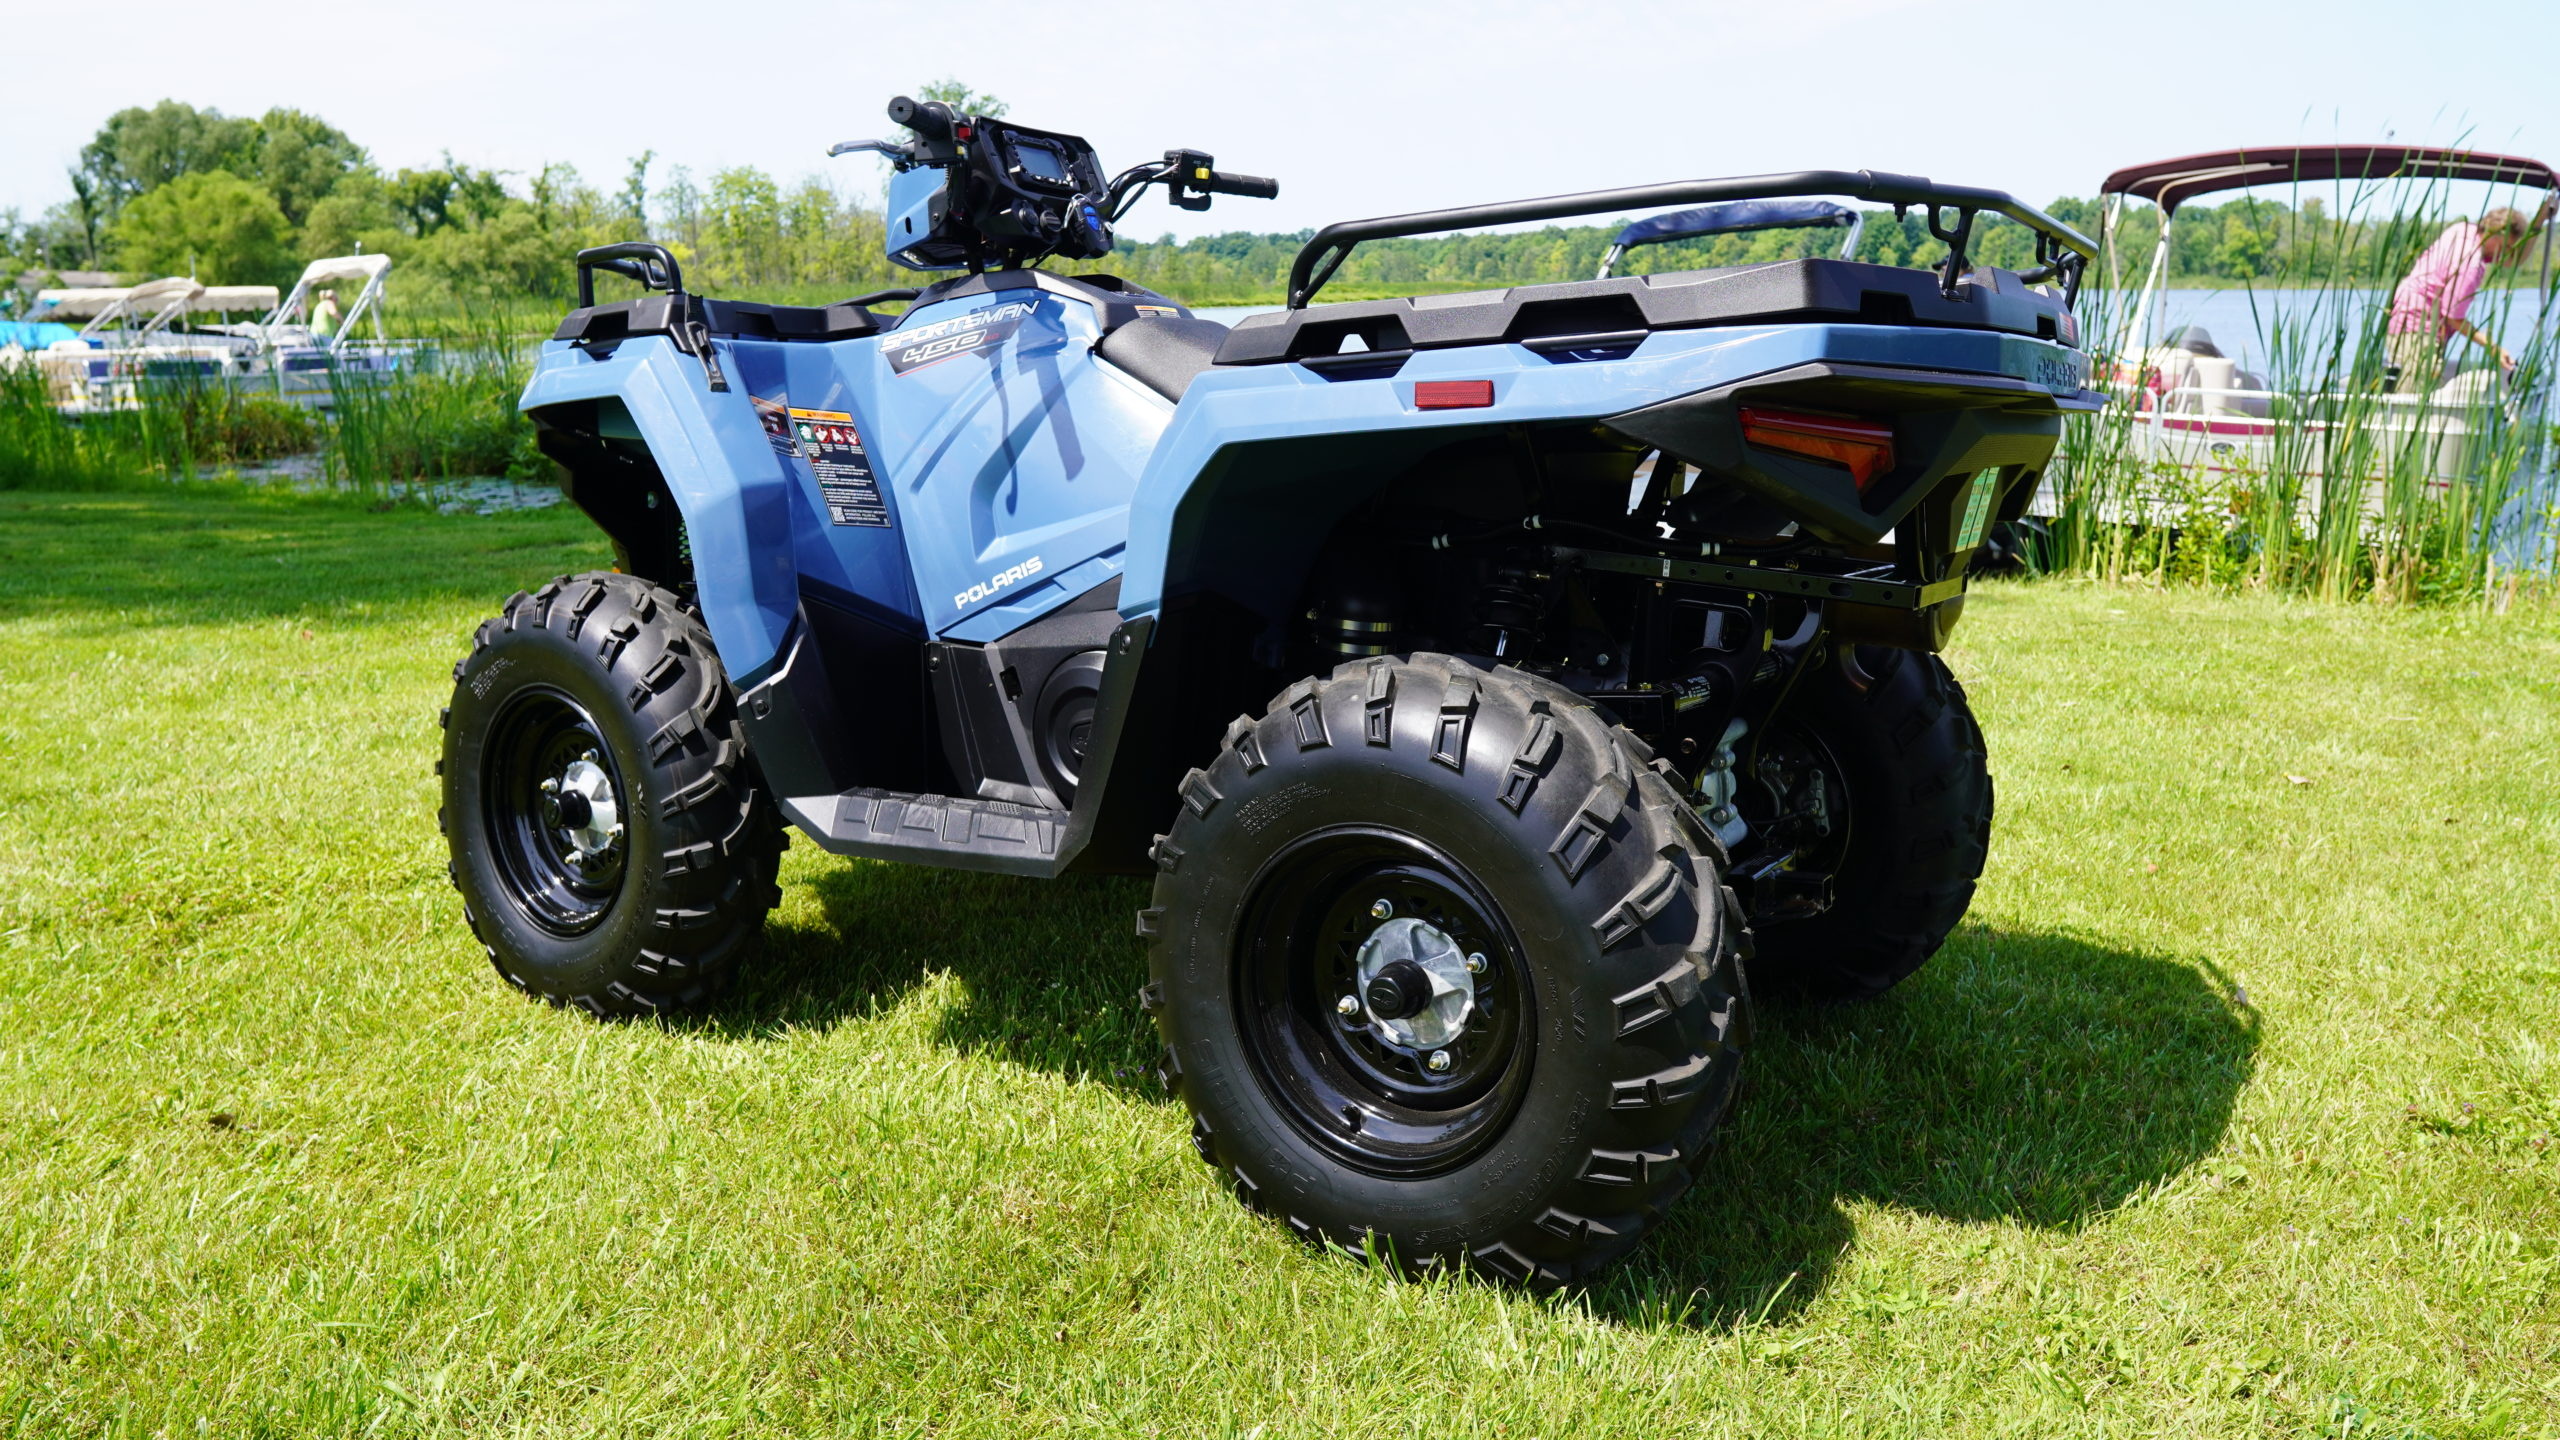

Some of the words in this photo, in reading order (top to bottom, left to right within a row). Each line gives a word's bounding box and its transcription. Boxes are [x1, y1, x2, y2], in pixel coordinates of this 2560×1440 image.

[880, 300, 1041, 352] SPORTSMAN
[902, 329, 987, 363] 450
[2037, 358, 2077, 389] POLARIS
[954, 555, 1043, 610] POLARIS
